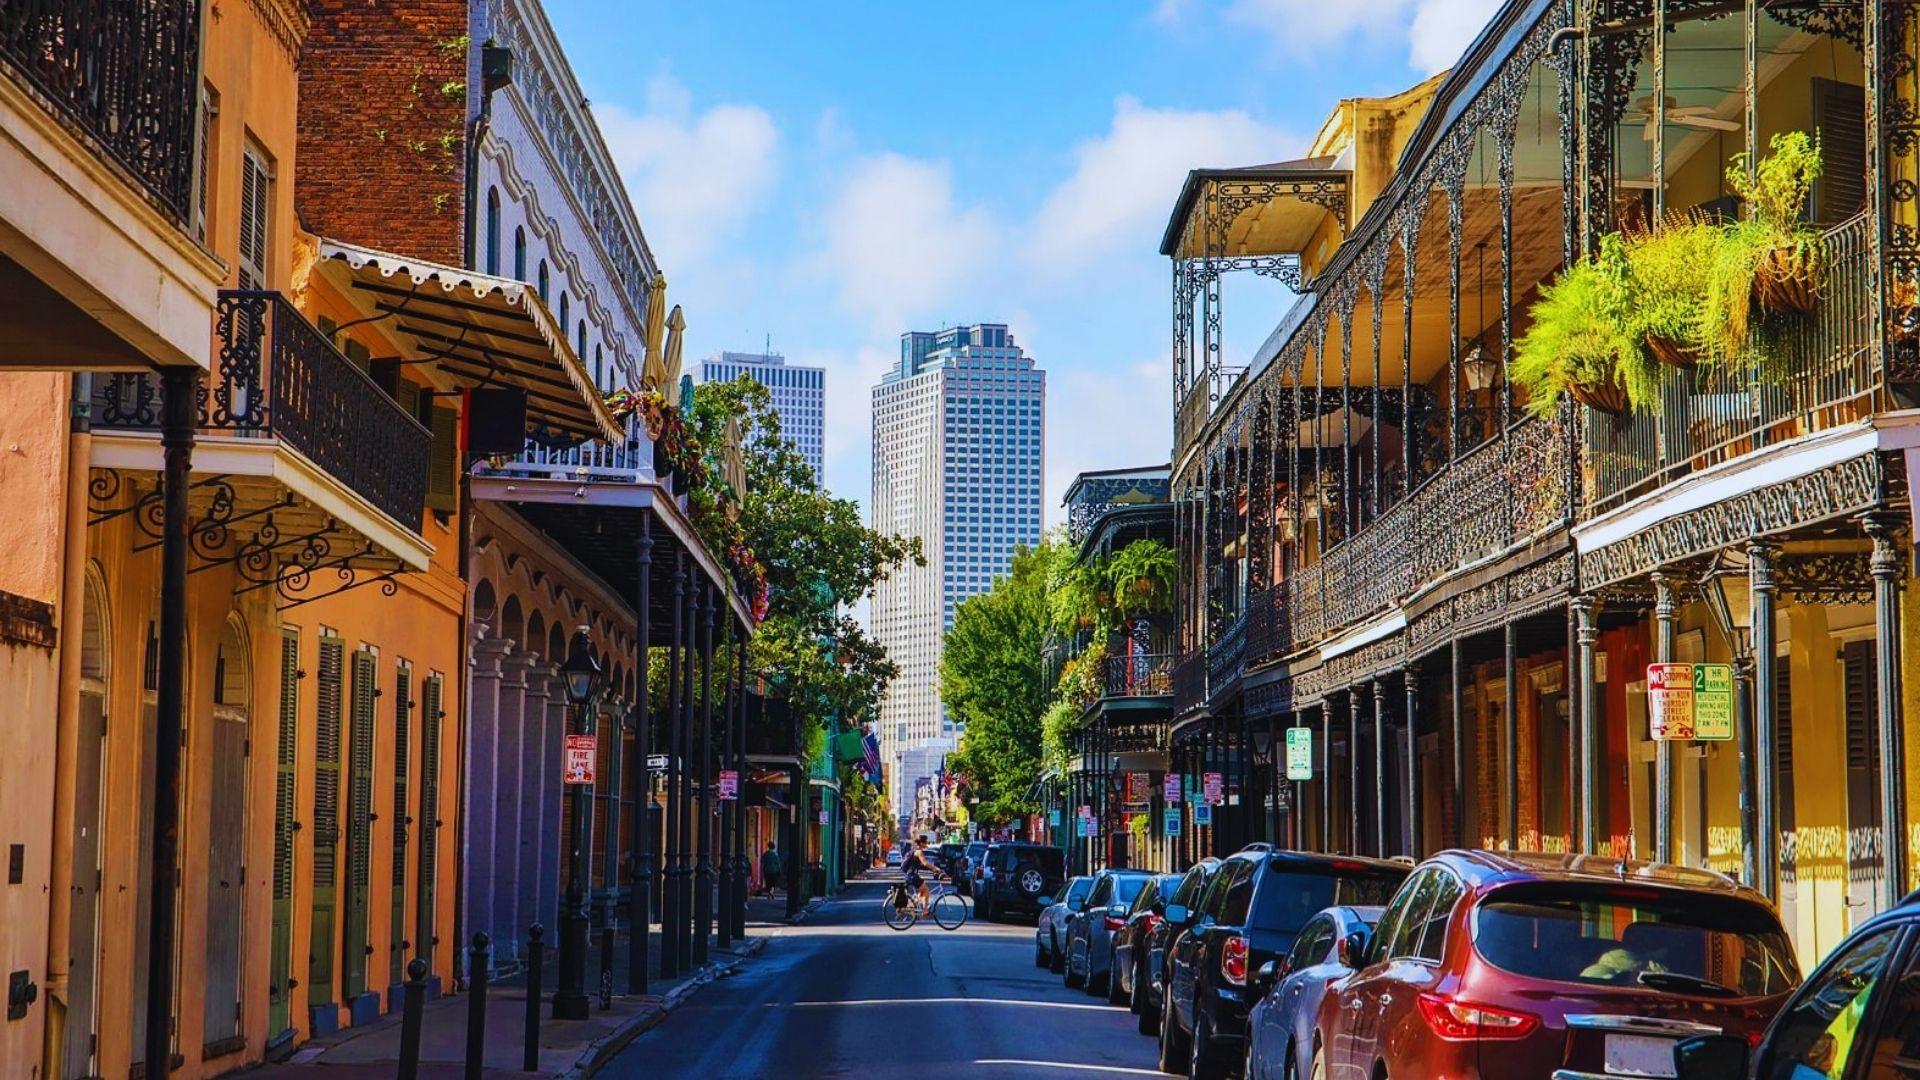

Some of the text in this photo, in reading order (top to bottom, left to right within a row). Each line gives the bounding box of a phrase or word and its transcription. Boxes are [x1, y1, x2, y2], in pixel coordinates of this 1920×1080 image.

[1650, 670, 1663, 684] NO
[1664, 672, 1691, 681] STOPPING
[1712, 668, 1722, 677] HR
[1695, 669, 1704, 688] 2
[1706, 680, 1728, 689] PARKING
[1288, 731, 1294, 742] 2
[568, 738, 577, 747] NO
[573, 751, 589, 759] FIRE
[571, 761, 589, 769] LANE
